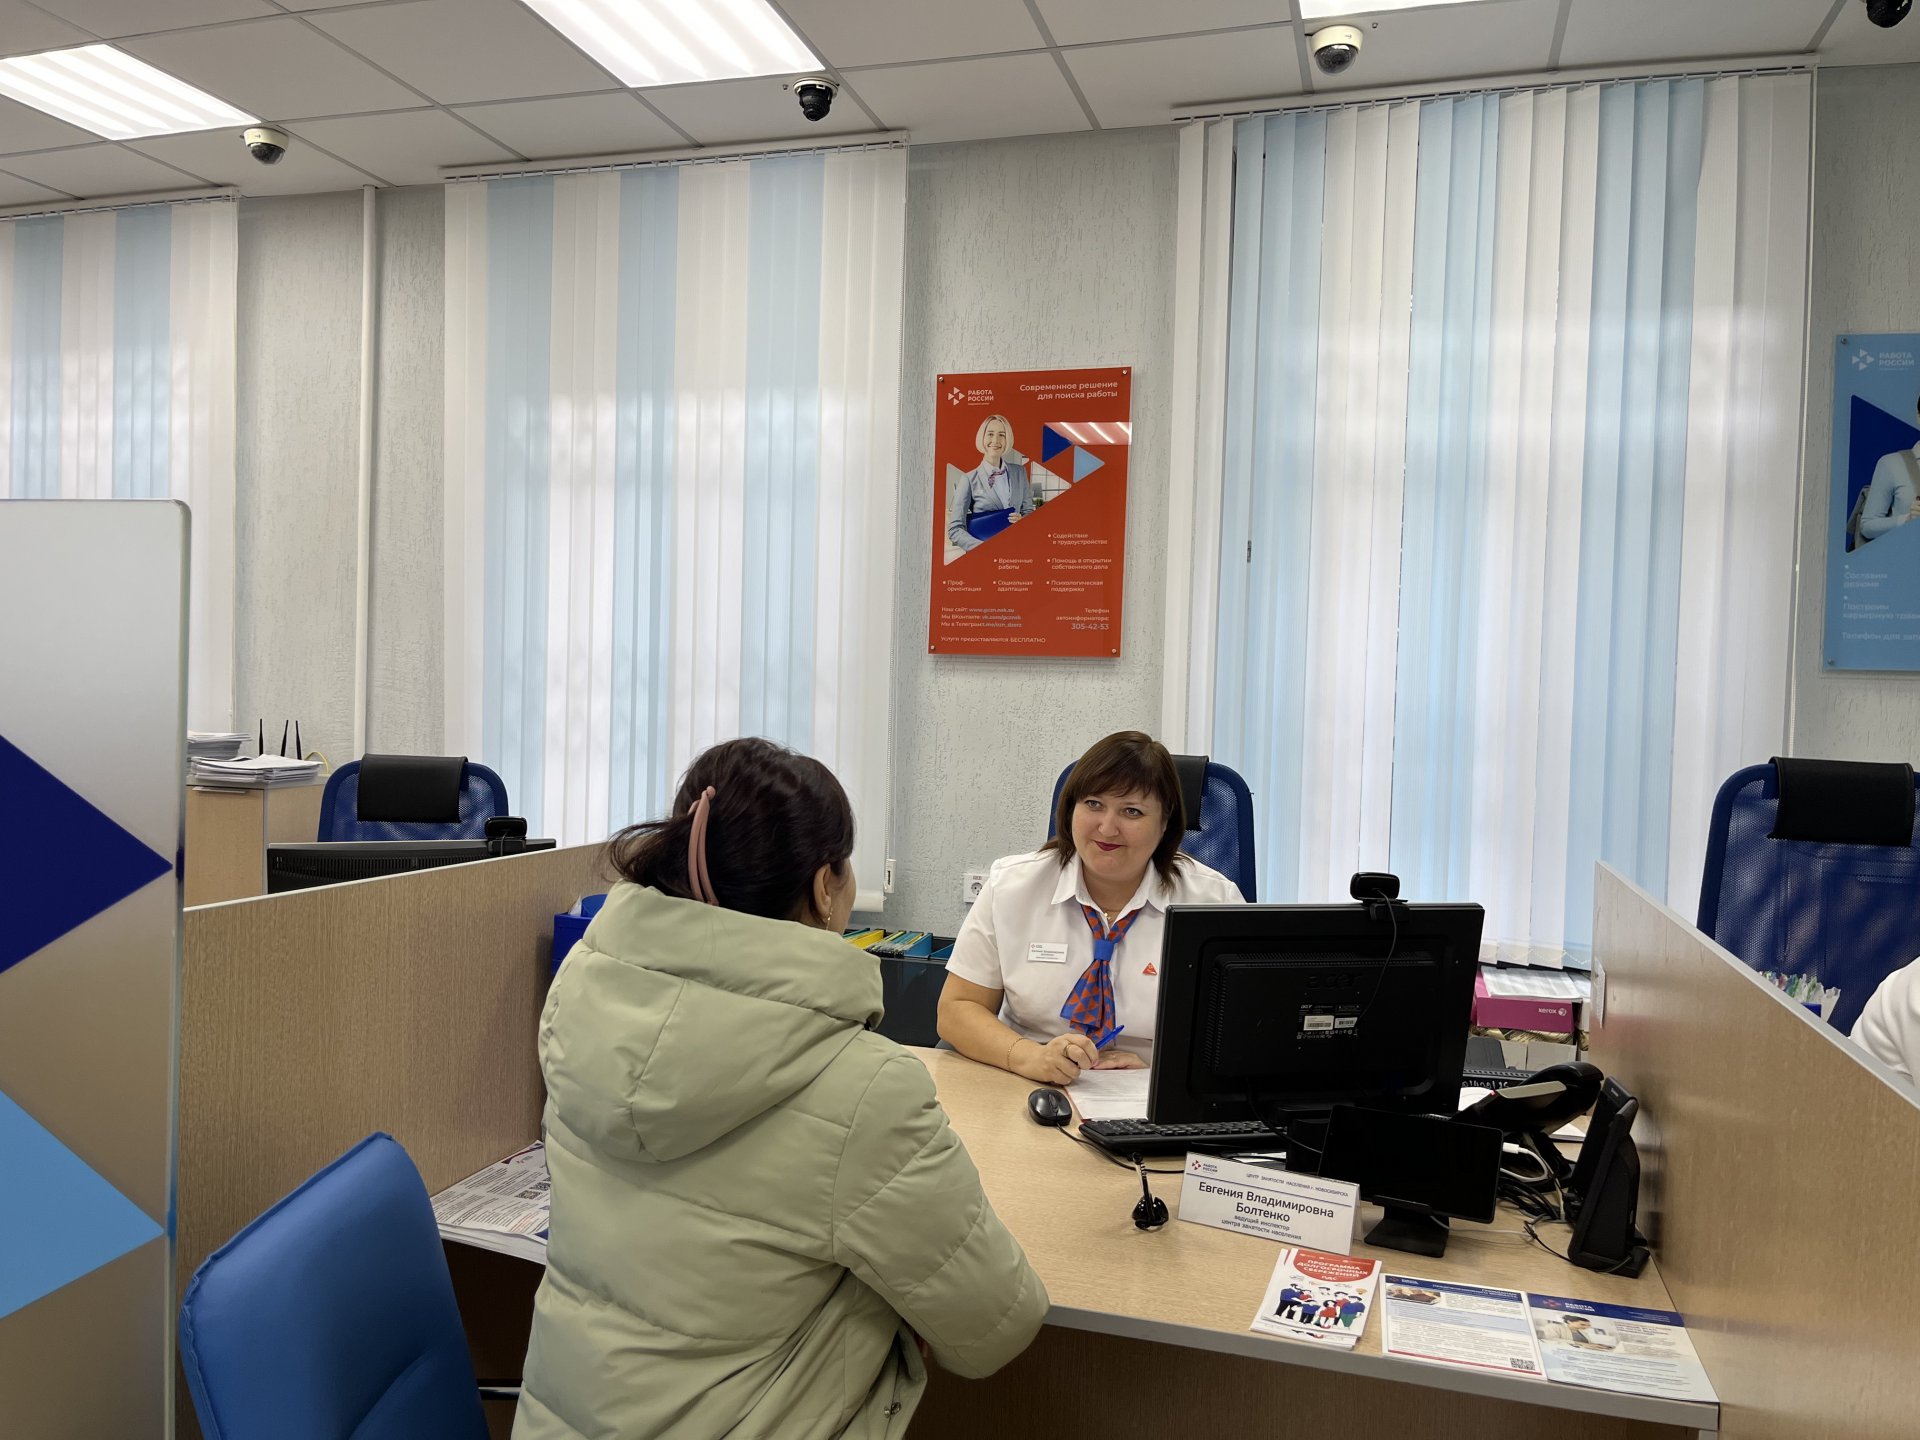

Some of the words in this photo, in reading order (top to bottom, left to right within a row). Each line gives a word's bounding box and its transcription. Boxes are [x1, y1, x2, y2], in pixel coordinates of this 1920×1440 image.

[1879, 359, 1915, 367] РОССИИ
[1020, 383, 1077, 392] Современное
[1079, 381, 1118, 391] решение
[1037, 392, 1053, 400] для
[1086, 390, 1118, 399] работы
[1260, 1175, 1285, 1185] ЗАНЯТОСТИ
[1198, 1181, 1243, 1199] Евгения
[1246, 1191, 1334, 1218] Владимировна
[1236, 1202, 1290, 1222] Болтенко
[1234, 1215, 1259, 1225] ведущий
[1260, 1220, 1290, 1231] инспектор
[1222, 1219, 1241, 1228] центра
[1242, 1222, 1270, 1234] занятости
[1272, 1229, 1302, 1240] населения
[1296, 1262, 1368, 1275] ДОЛГОСРОЧНЫХ
[1308, 1260, 1360, 1270] ПРОГРАММА
[1304, 1267, 1360, 1278] СБЕРЕЖЕНИЙ
